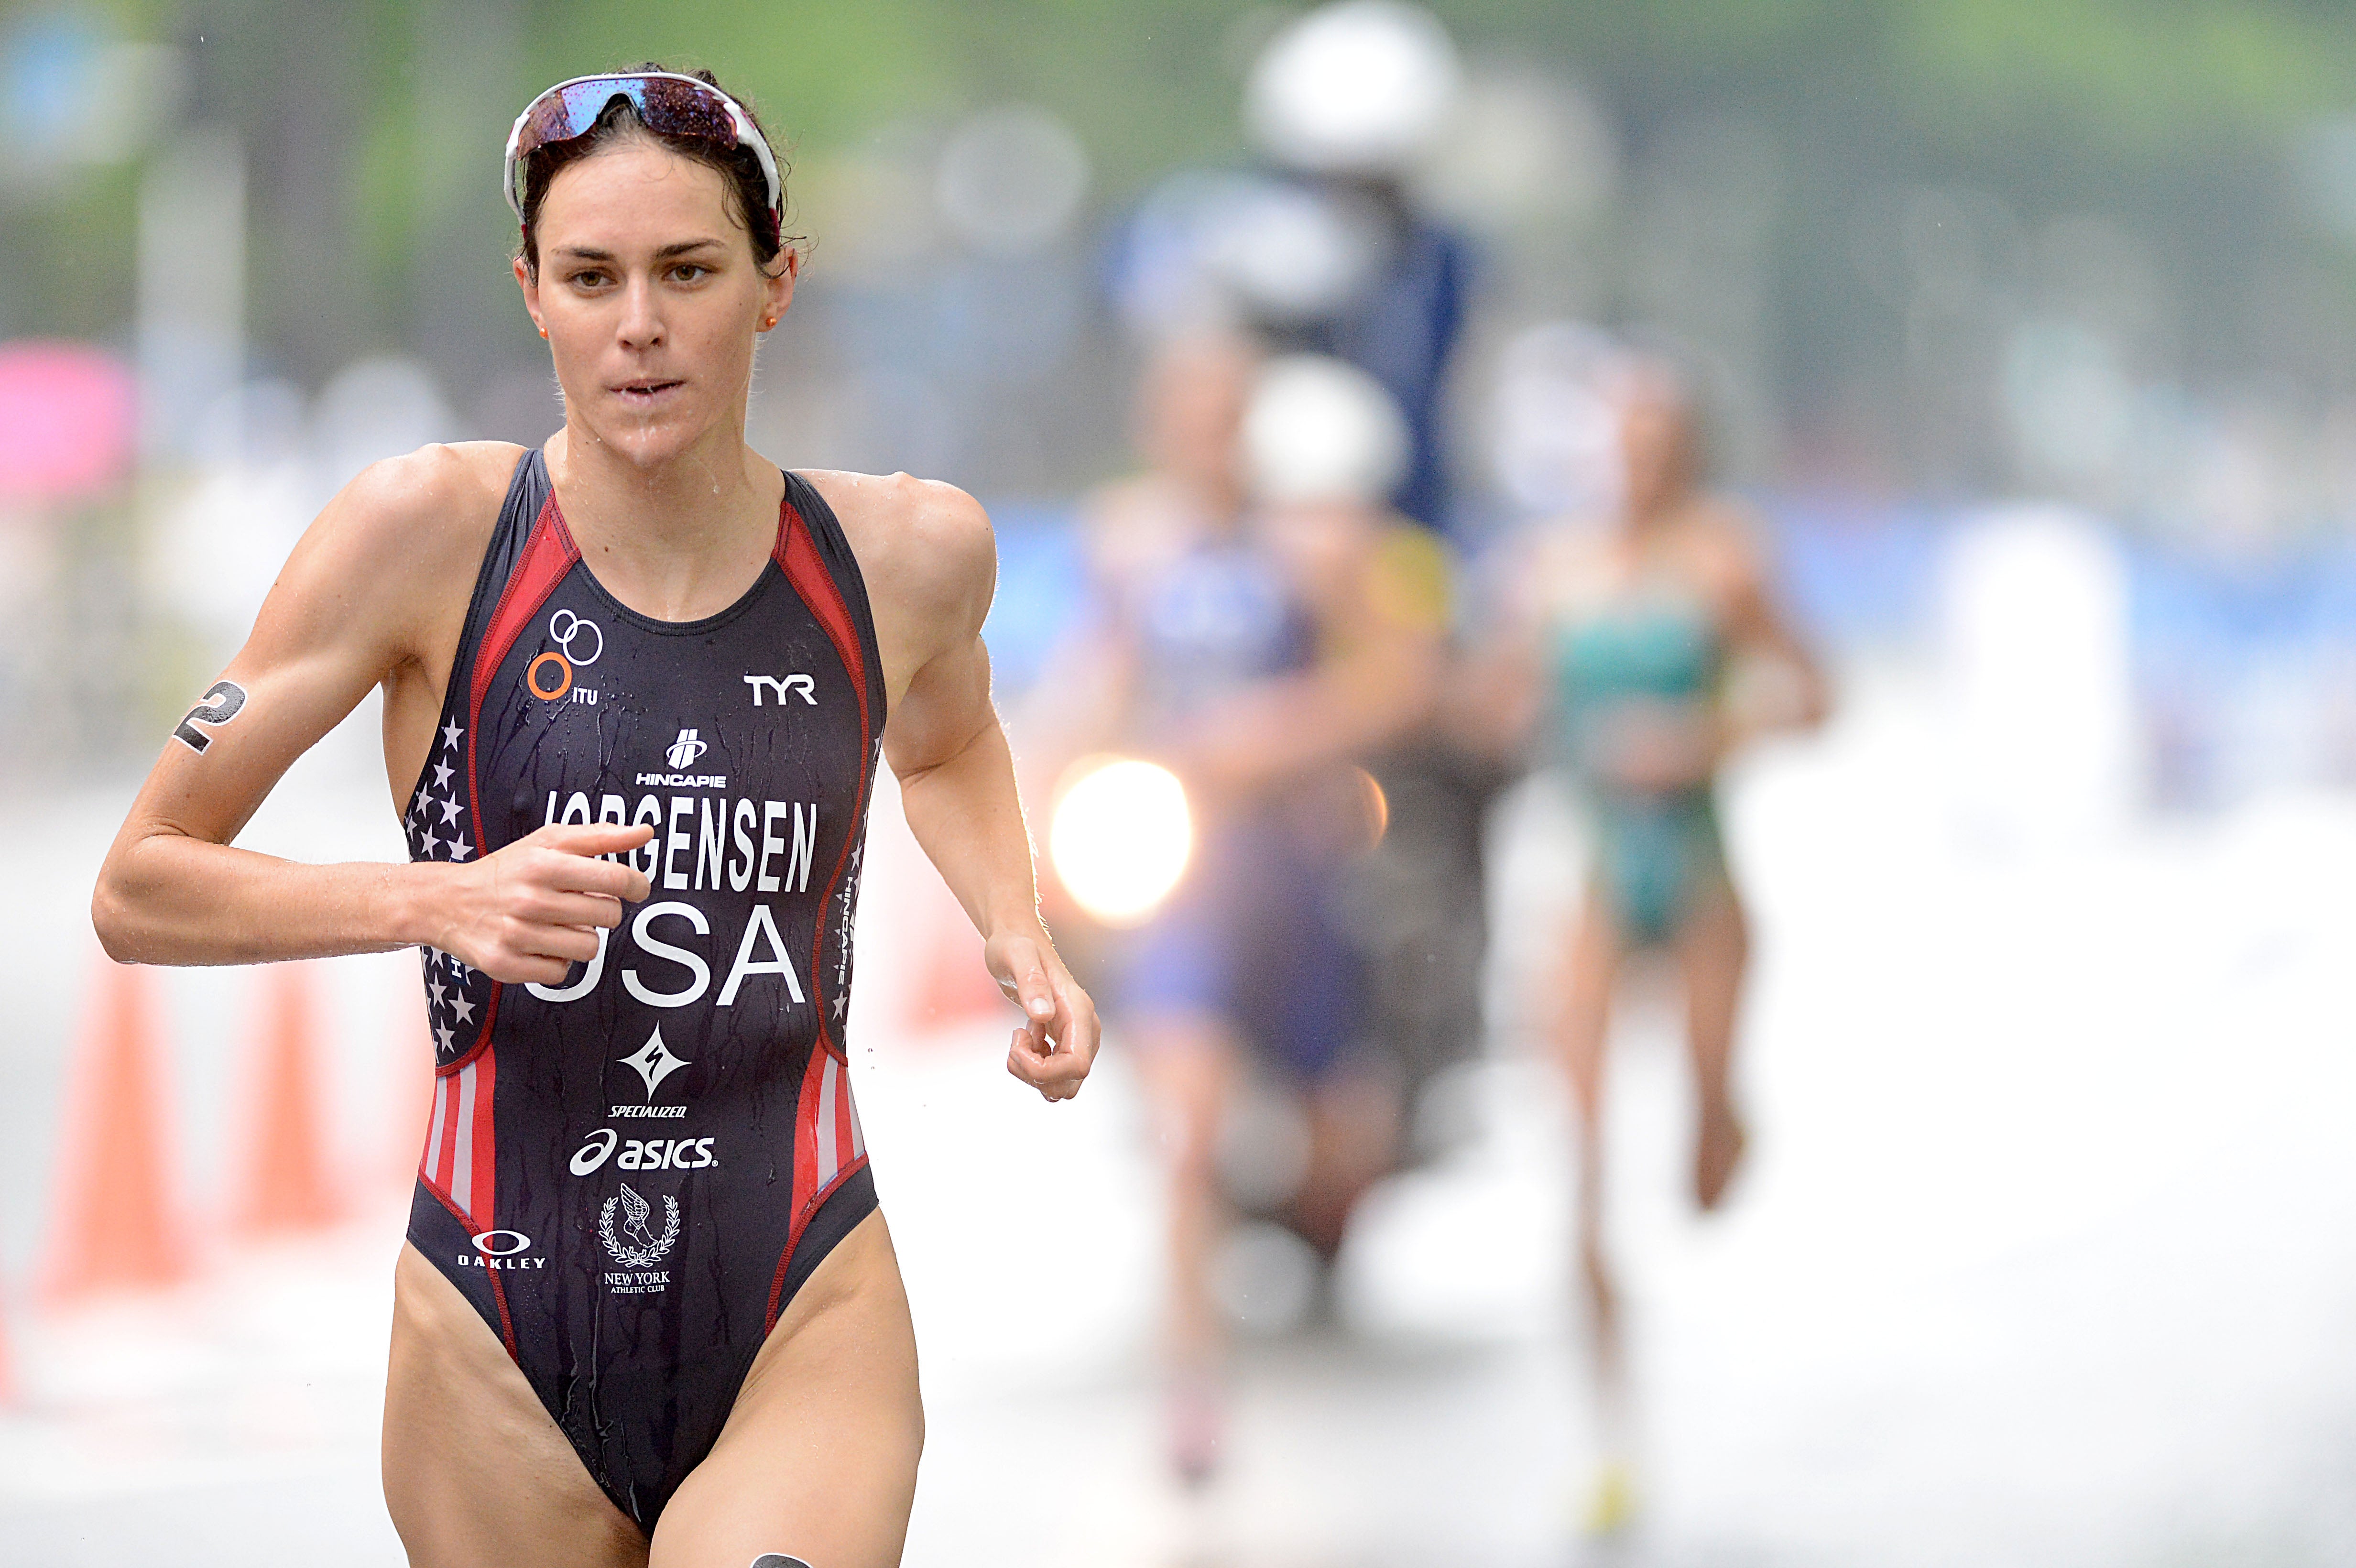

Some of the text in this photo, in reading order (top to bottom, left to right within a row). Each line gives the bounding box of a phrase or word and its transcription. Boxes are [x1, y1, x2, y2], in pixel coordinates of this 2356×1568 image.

[572, 686, 598, 706] ITU
[744, 674, 818, 706] TYR
[172, 680, 248, 756] 2
[635, 773, 727, 789] HINCAPIE
[838, 876, 853, 985] HINCAPIE
[458, 1255, 545, 1270] OAKLEY
[604, 1271, 670, 1286] NEW YORK
[647, 1285, 665, 1293] CLUB
